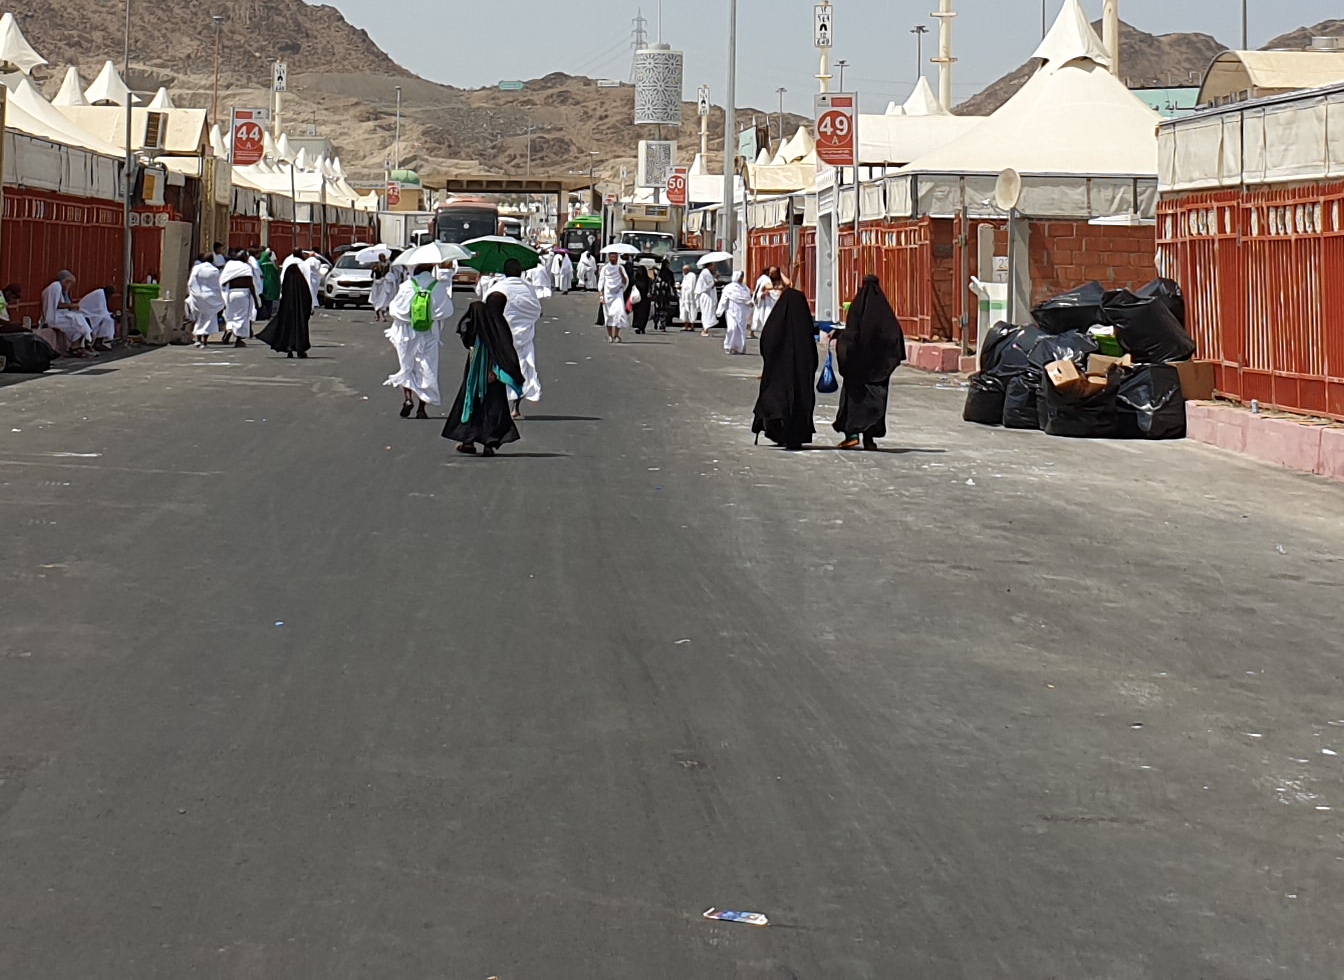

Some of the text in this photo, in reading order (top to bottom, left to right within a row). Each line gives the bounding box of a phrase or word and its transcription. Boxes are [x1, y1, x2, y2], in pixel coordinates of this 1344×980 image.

[819, 116, 848, 136] 49
[236, 125, 260, 141] 44
[246, 141, 252, 149] A
[831, 135, 839, 145] A
[668, 178, 684, 189] 50
